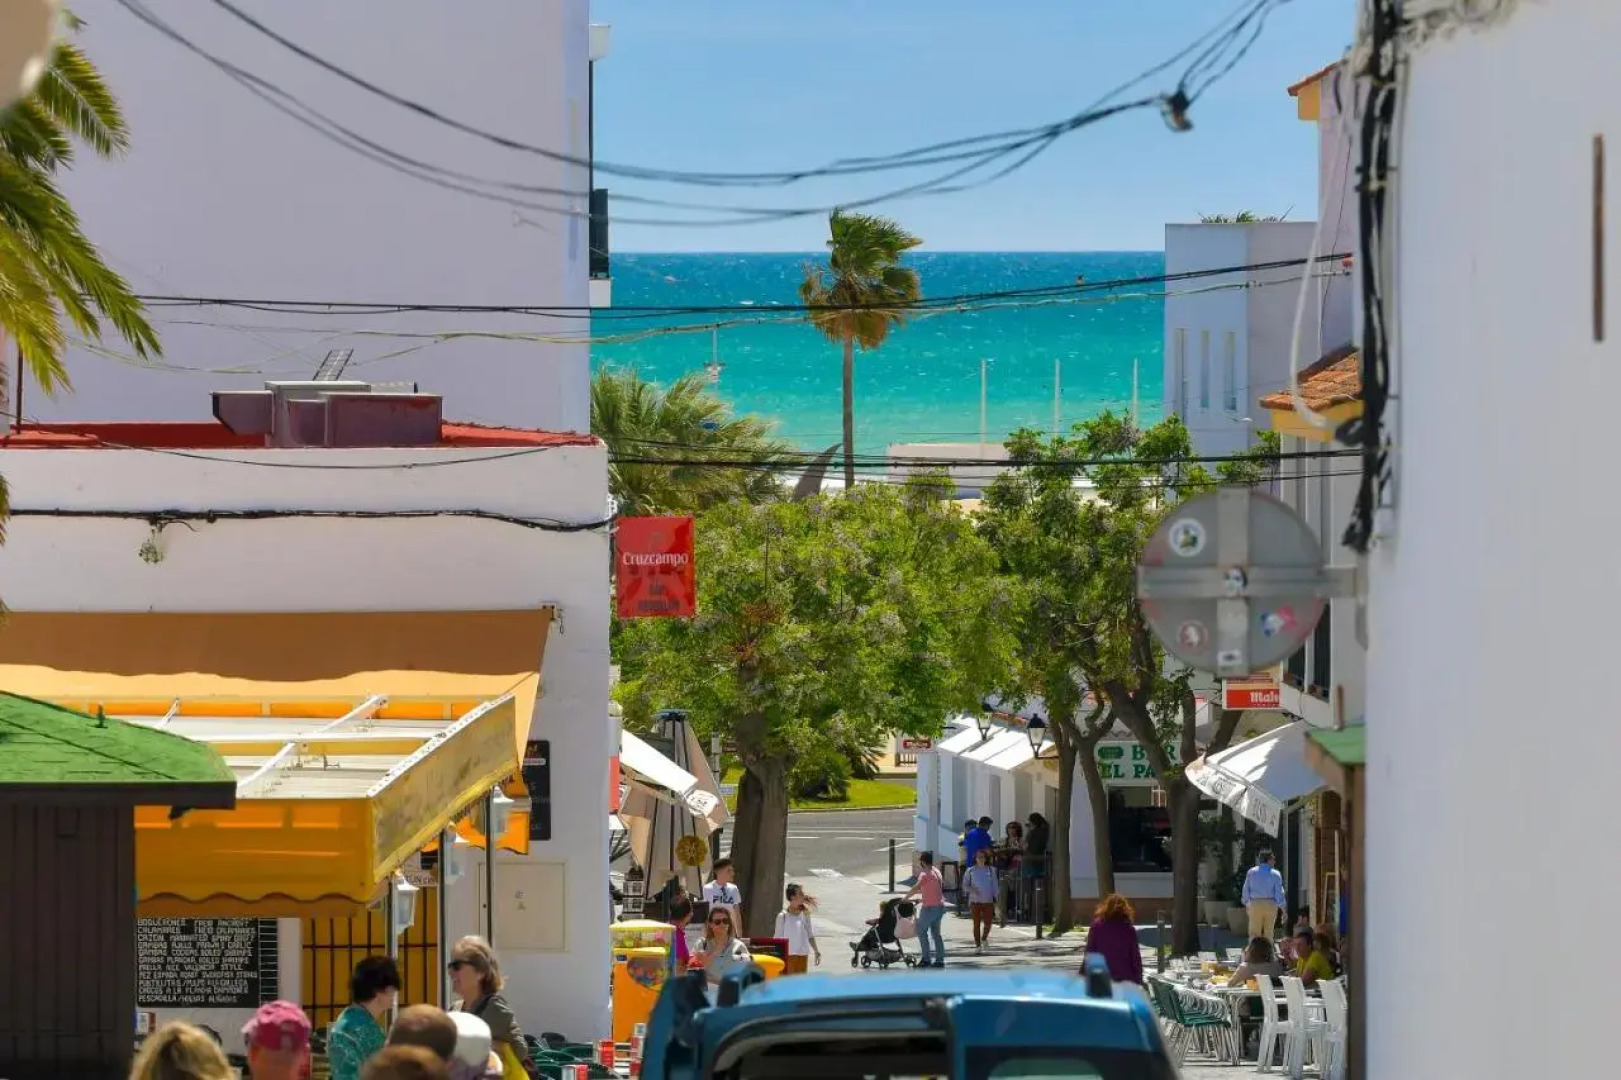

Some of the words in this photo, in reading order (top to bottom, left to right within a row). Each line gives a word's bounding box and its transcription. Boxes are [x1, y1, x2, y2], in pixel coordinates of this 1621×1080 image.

[622, 551, 689, 567] Cruzcampo
[1131, 742, 1177, 760] BR
[1098, 763, 1125, 778] EL
[712, 894, 734, 905] FILA
